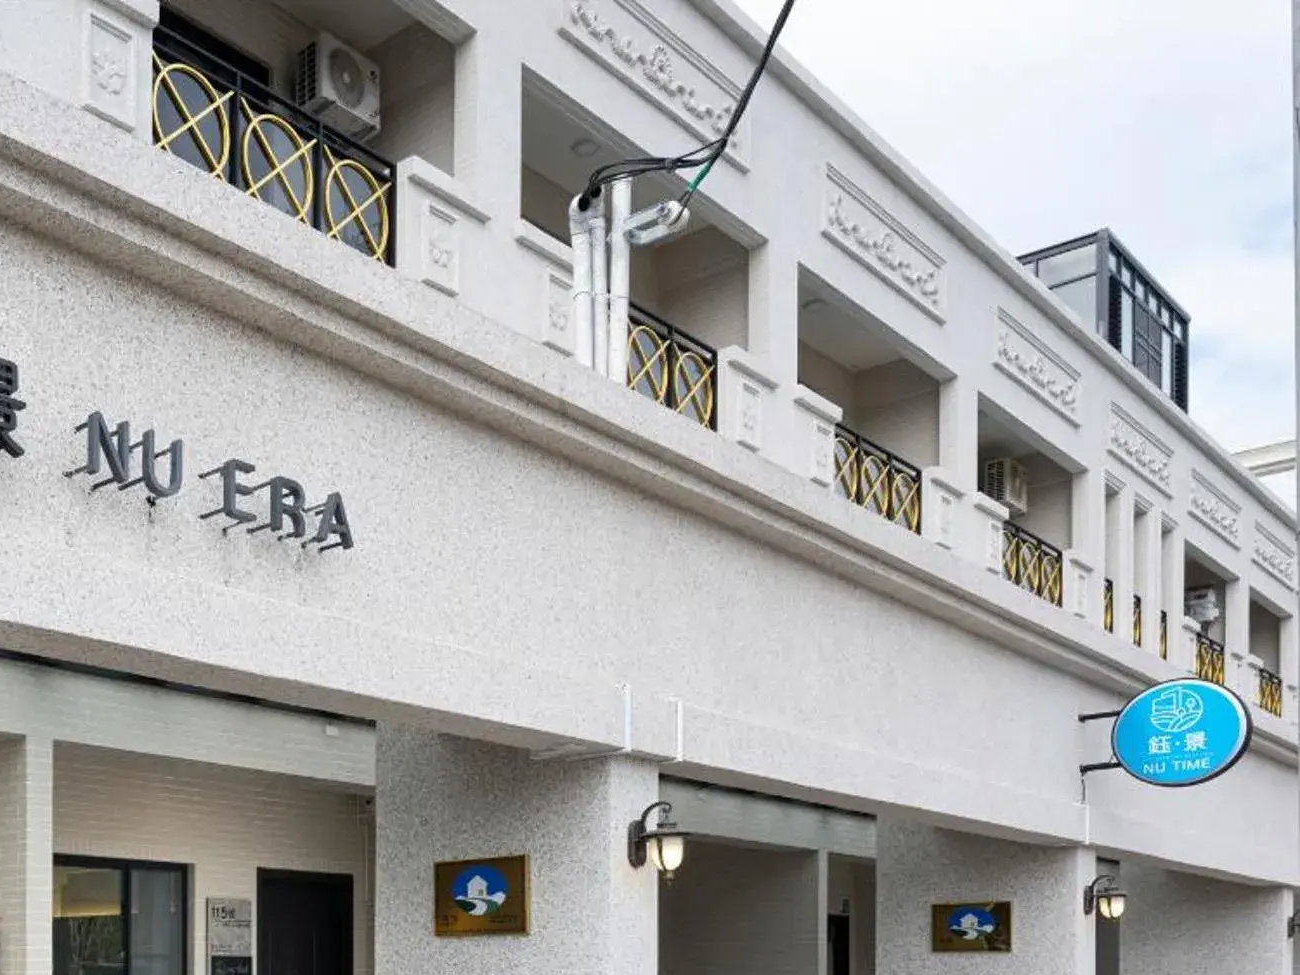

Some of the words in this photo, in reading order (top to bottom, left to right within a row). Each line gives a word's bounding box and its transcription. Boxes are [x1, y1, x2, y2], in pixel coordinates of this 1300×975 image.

[82, 411, 184, 499] NU
[220, 457, 355, 550] ERA
[1143, 762, 1166, 774] NU
[1172, 757, 1211, 772] TIME
